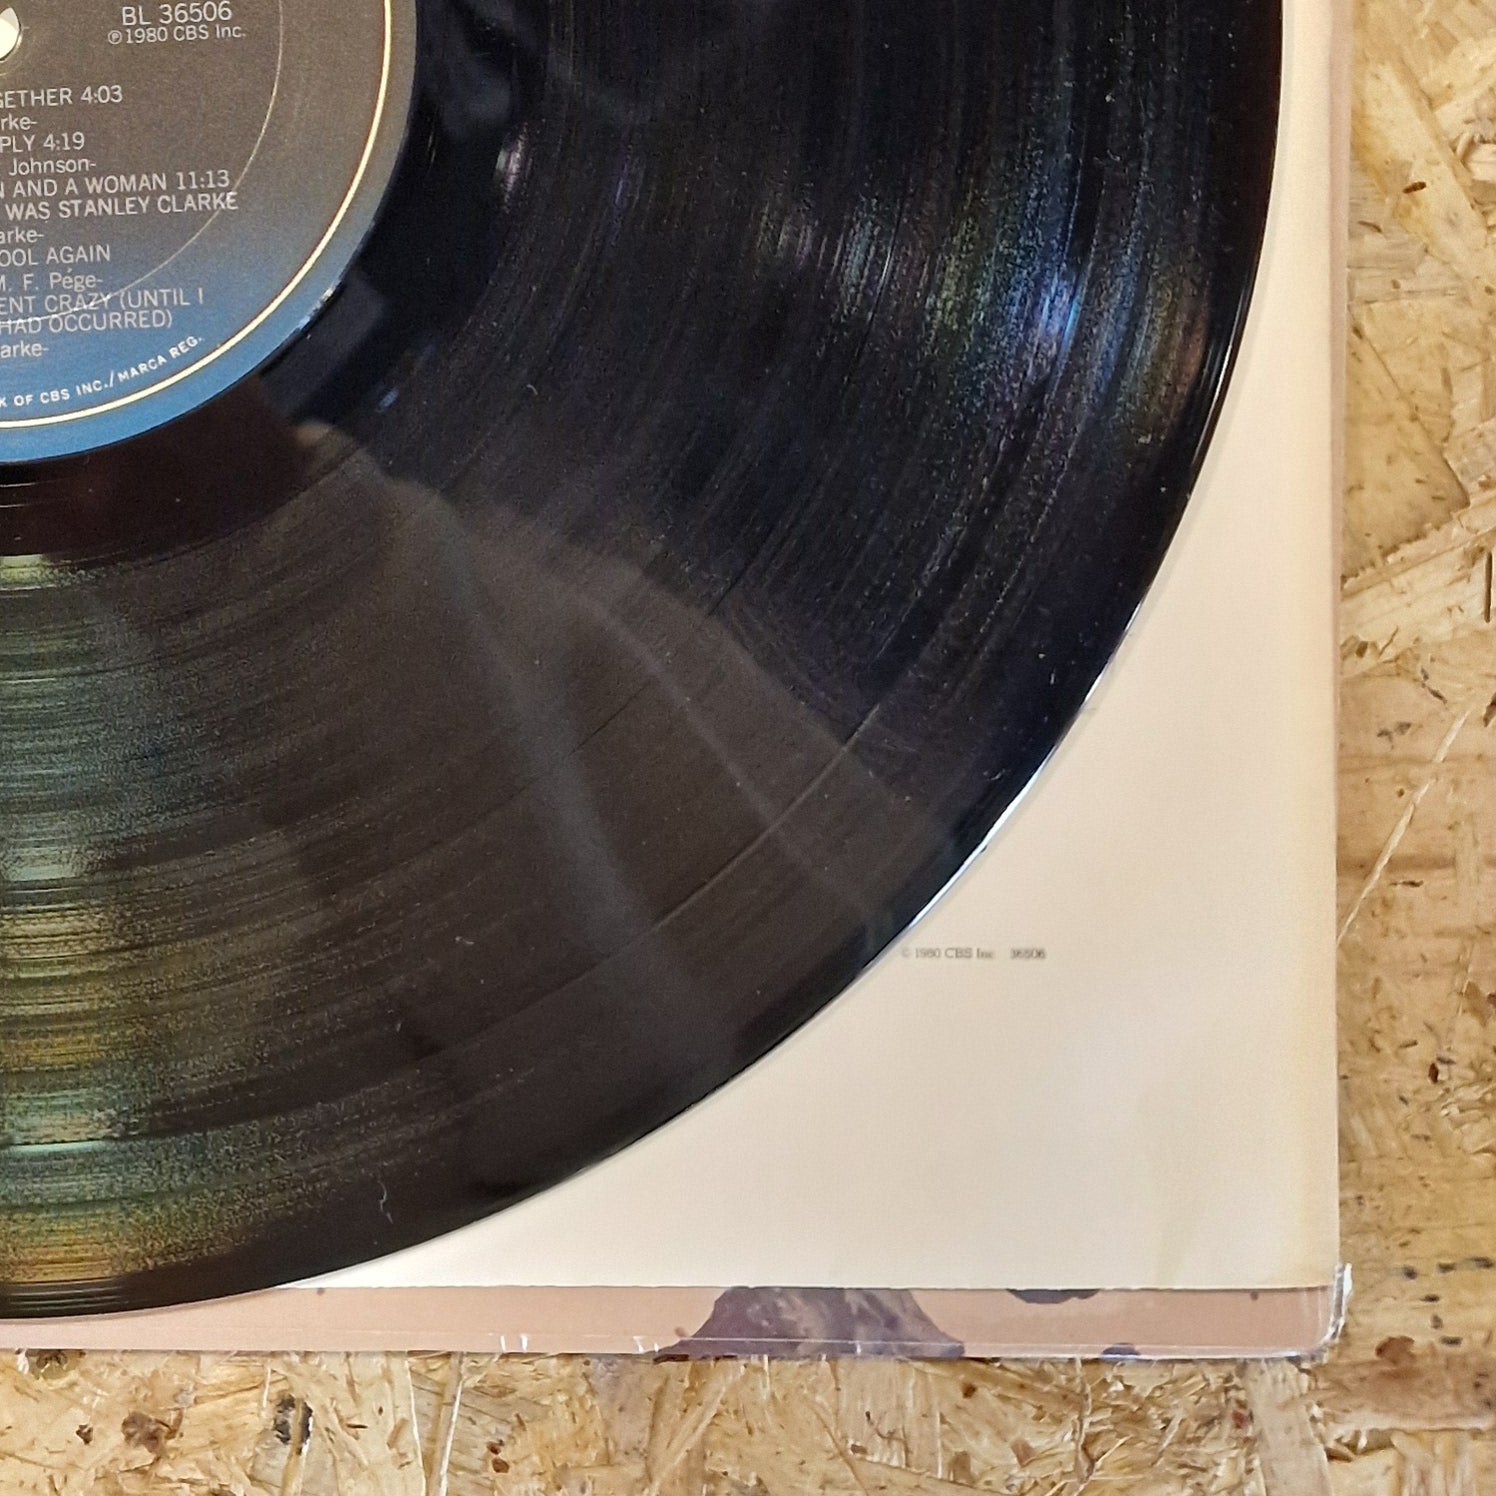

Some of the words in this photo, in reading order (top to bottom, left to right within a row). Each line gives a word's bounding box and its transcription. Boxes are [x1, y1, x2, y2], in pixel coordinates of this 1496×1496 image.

[121, 6, 151, 26] BL
[159, 0, 232, 24] 36506
[173, 25, 209, 41] CBS
[216, 23, 246, 39] Inc.
[80, 85, 123, 104] 4:03
[43, 131, 85, 151] 4:19
[9, 157, 96, 177] Johnson-
[13, 179, 58, 198] AND
[65, 178, 78, 195] A
[85, 173, 166, 194] WOMAN
[176, 169, 230, 189] 11:13
[5, 202, 50, 221] WAS
[58, 196, 150, 219] STANLEY
[157, 191, 239, 214] CLARKE
[46, 244, 110, 264] AGAIN
[23, 273, 39, 290] F.
[45, 292, 112, 313] CRAZY
[119, 288, 190, 310] (UNTIL
[198, 288, 203, 304] I
[49, 310, 172, 333] OCCURRED)
[13, 394, 33, 407] OF
[40, 389, 70, 403] CBS
[169, 335, 204, 359] REG.
[944, 947, 973, 959] CBS
